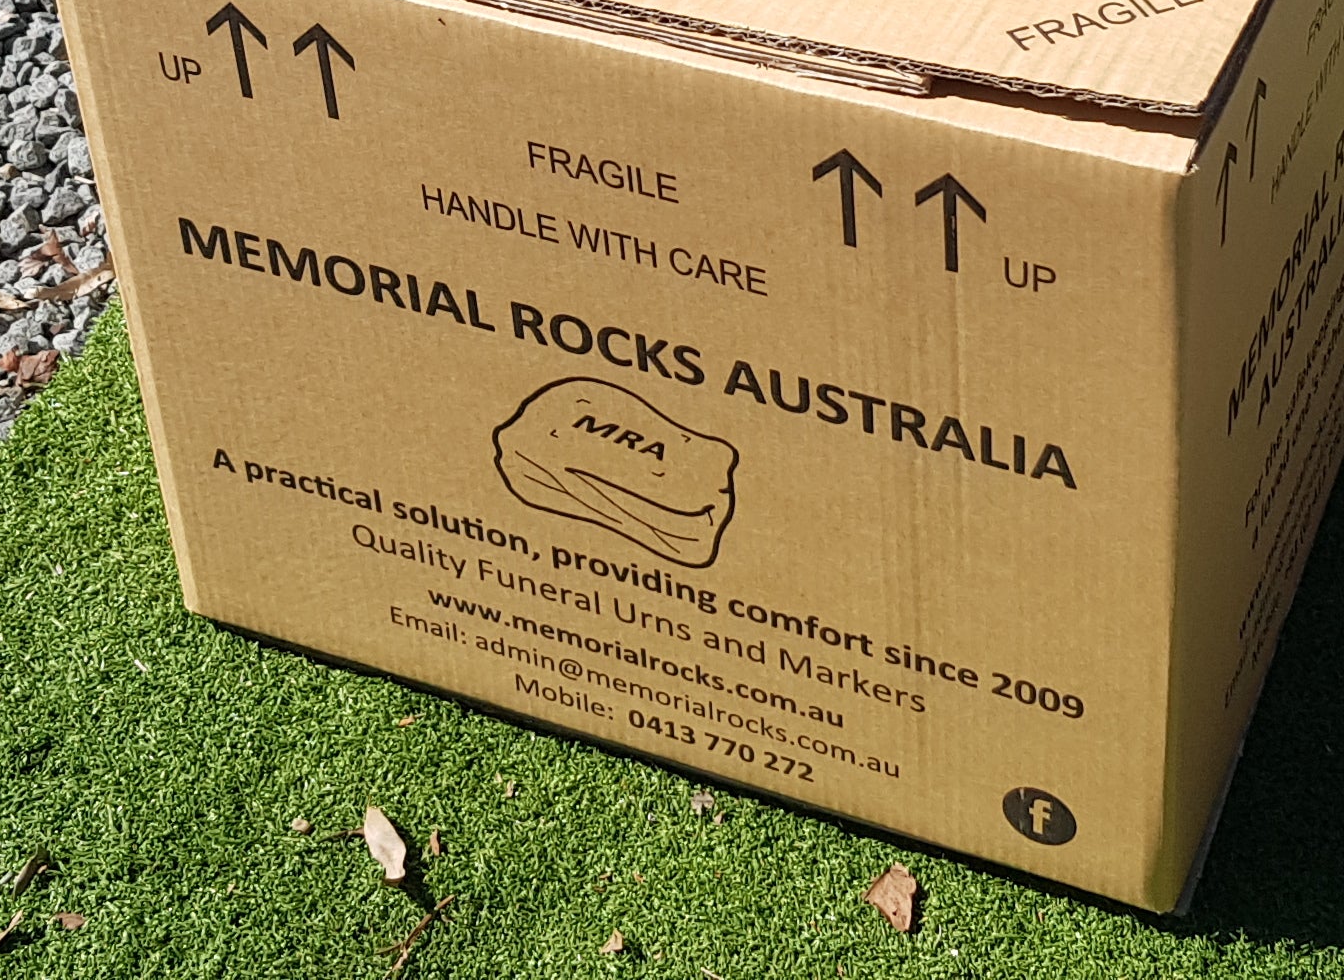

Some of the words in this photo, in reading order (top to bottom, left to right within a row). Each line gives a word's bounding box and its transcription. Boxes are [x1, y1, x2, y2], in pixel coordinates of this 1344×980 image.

[158, 51, 202, 85] UP
[527, 140, 679, 204] FRAGILE
[421, 183, 560, 244] HANDLE
[567, 219, 657, 269] WITH
[668, 247, 769, 297] CARE
[1003, 256, 1057, 293] UP
[1227, 171, 1330, 436] MEMORIAL
[177, 216, 496, 333] MEMORIAL
[510, 300, 706, 387] ROCKS
[722, 359, 1078, 491] AUSTRALIA
[572, 414, 665, 460] MRA
[212, 447, 237, 474] A
[243, 458, 383, 514] practical
[392, 498, 542, 562] solution,
[550, 542, 718, 615] providing
[727, 596, 874, 658] comfort
[883, 643, 980, 690] since
[990, 671, 1085, 720] 2009
[351, 522, 468, 579] Quality
[478, 558, 602, 616] Funeral
[612, 597, 692, 643] Urns
[702, 628, 767, 665] and
[778, 647, 927, 714] Markers
[389, 605, 469, 646] Email:
[475, 634, 902, 779] admin@memorialrocks.com.au
[427, 587, 845, 729] www.memorialrocks.com.au
[514, 672, 614, 722] Mobile:
[627, 708, 697, 747] 0413
[704, 732, 756, 764] 770
[763, 750, 816, 784] 272
